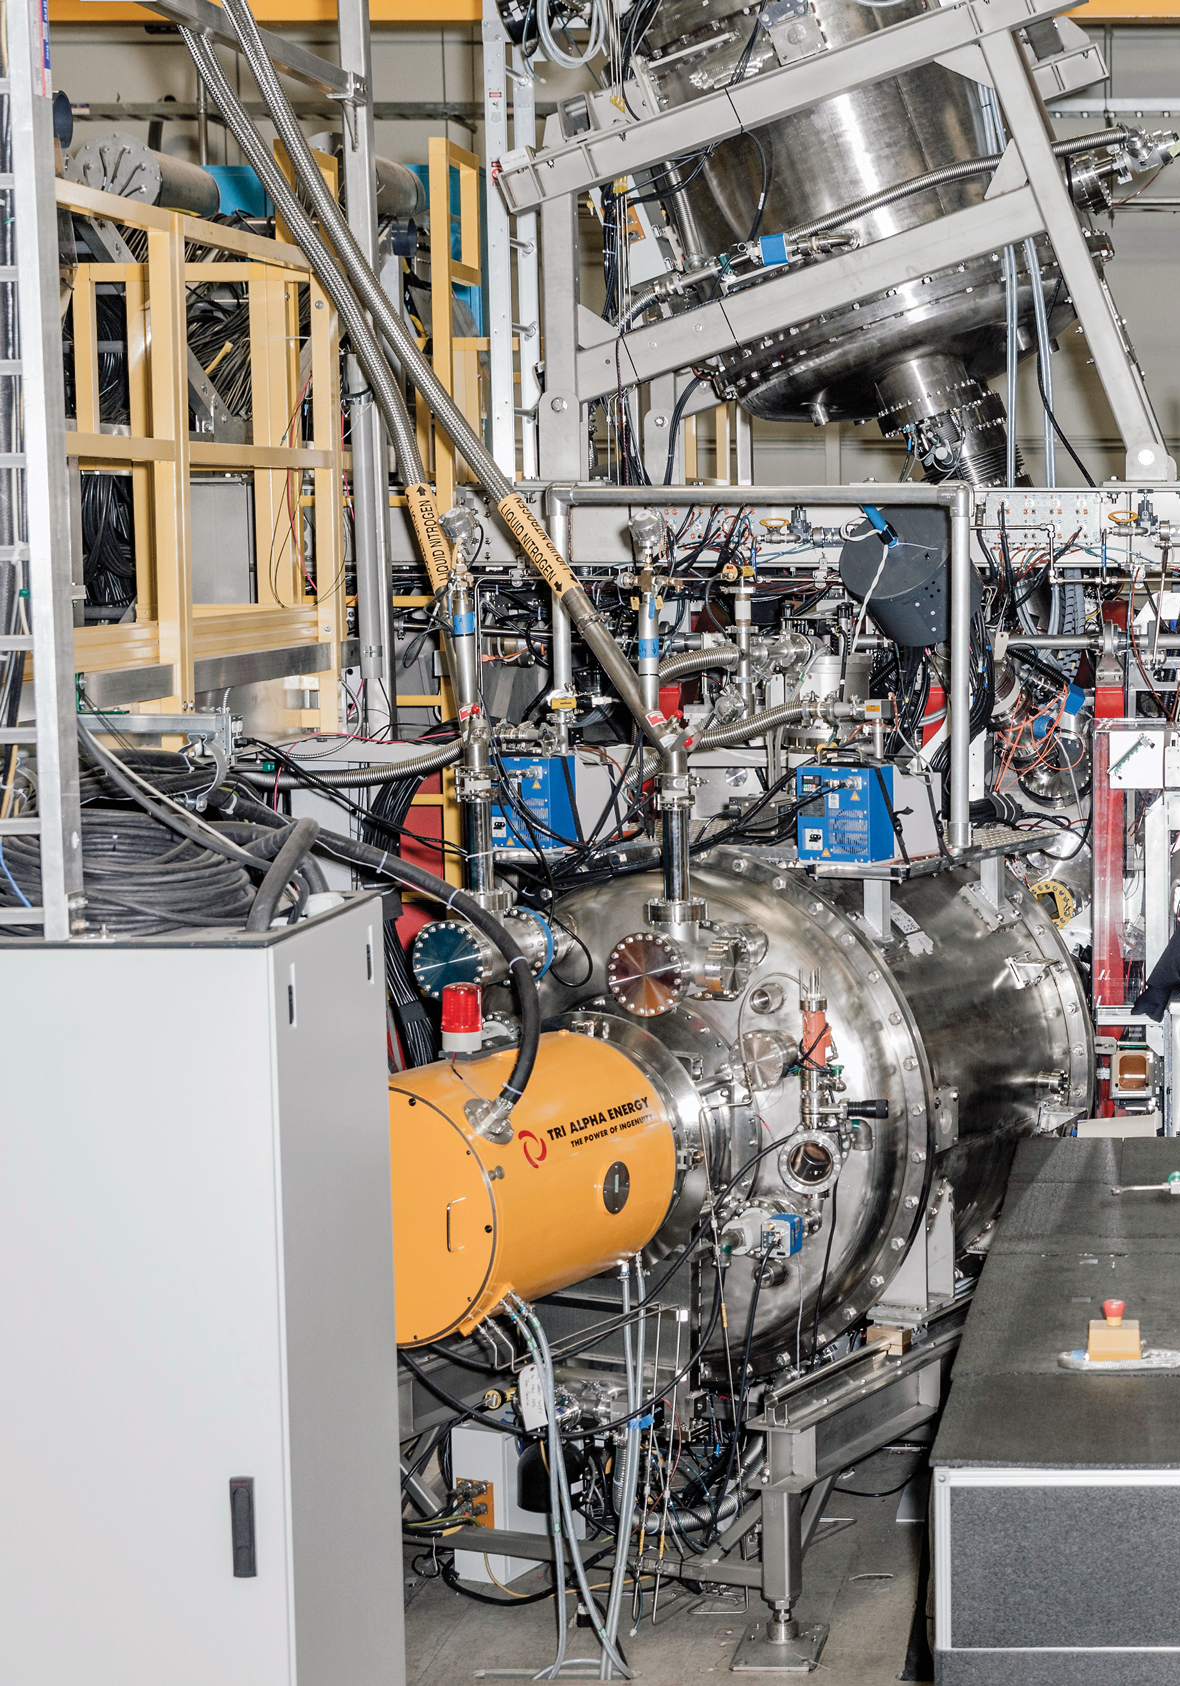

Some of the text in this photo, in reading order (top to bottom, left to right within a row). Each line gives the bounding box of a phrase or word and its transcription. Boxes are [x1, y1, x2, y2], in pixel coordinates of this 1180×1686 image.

[420, 499, 450, 582] LIQUID NITROGEN
[500, 503, 556, 582] LIQUID NITROGEN
[546, 1096, 650, 1141] TRI ALPHA ENERGY
[570, 1113, 653, 1148] THE POWER OF INGENUITY
